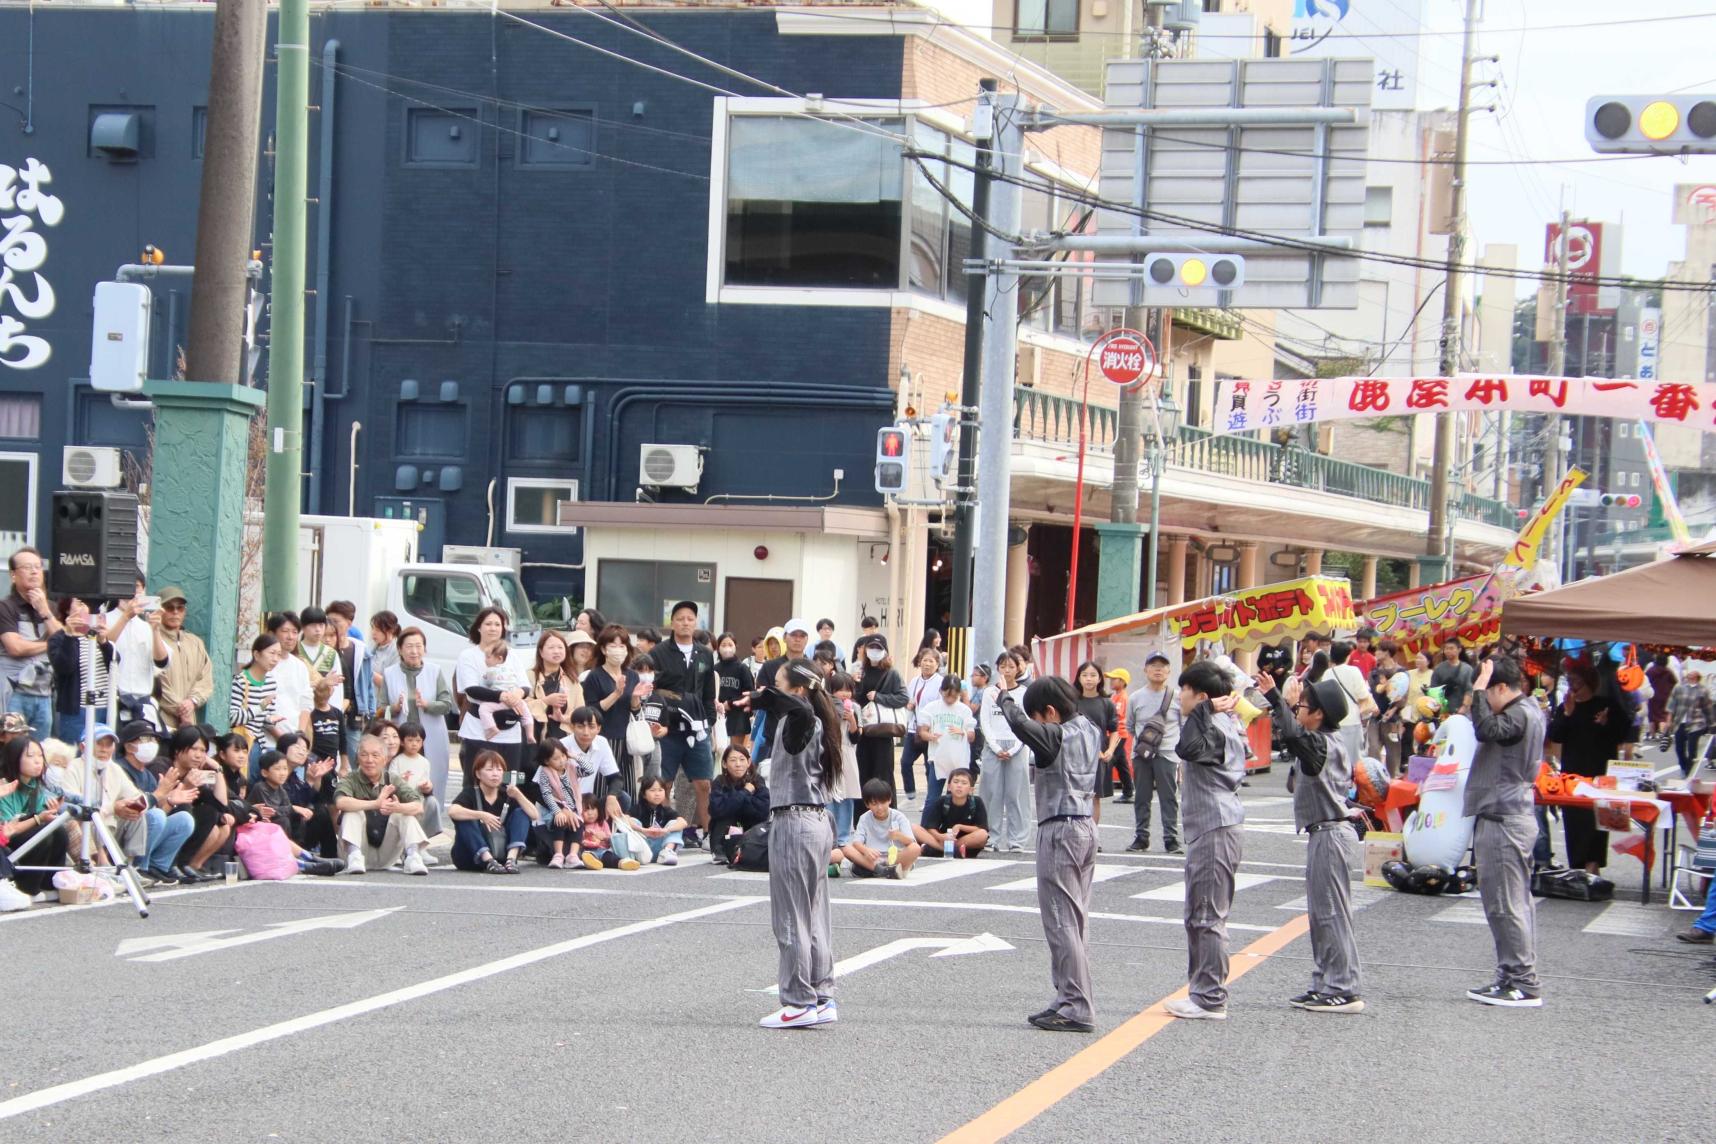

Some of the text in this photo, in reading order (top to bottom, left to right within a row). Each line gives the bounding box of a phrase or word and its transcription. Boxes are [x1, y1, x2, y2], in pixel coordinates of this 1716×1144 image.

[1377, 68, 1405, 90] 社
[0, 157, 65, 370] はるんち
[1102, 350, 1143, 372] 消火栓
[1348, 379, 1716, 421] 鹿屋本町一番
[60, 552, 96, 566] RAMSA
